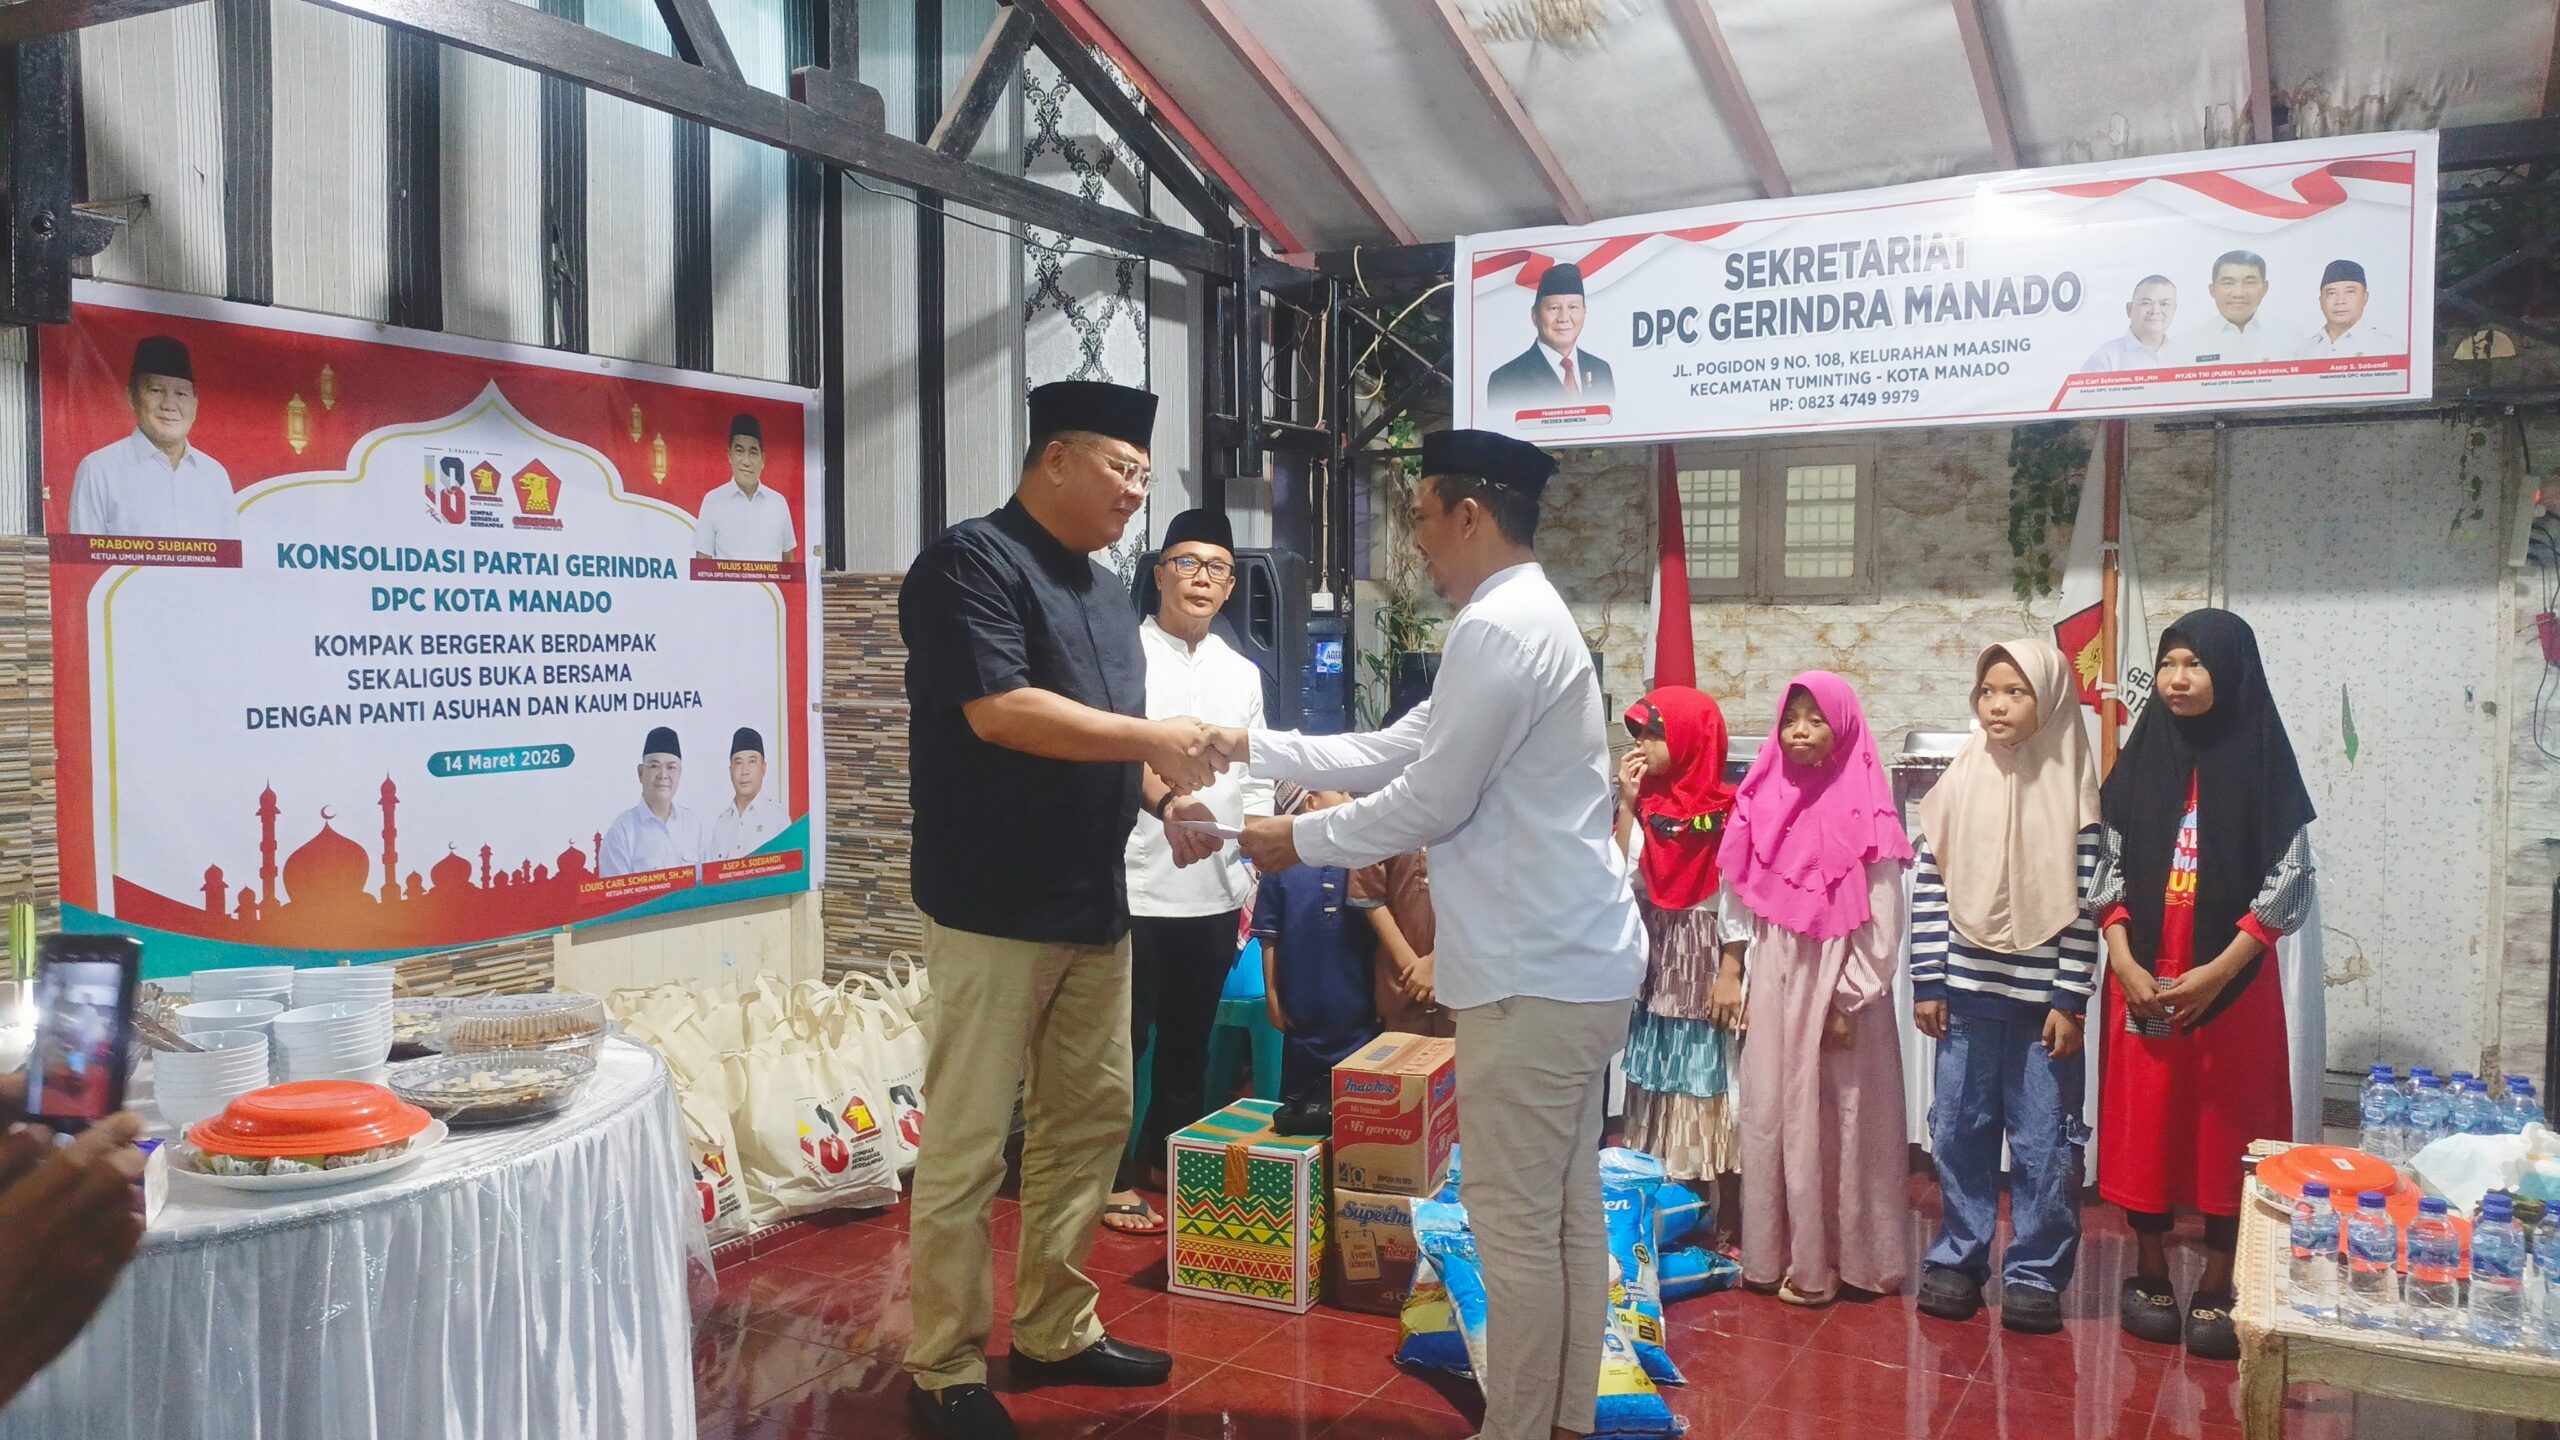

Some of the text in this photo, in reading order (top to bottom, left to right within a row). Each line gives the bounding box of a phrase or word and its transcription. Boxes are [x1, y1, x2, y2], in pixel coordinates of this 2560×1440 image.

[1632, 272, 2081, 347] DPC GERINDRA MANADO
[1673, 338, 2031, 379] JL. POGIDON 9 NO. 108, KELURAHAN MAASING
[1690, 376, 1781, 396] KECAMATAN
[1786, 371, 1871, 392] TUMINTING
[1887, 367, 1929, 384] KOTA
[1935, 362, 2010, 381] MANADO
[1769, 390, 1919, 412] HP: 0823 4749 9979
[89, 538, 217, 553] PRABOWO SUBIANTO
[91, 552, 217, 563] KETUA UMUM PARTAI GERINDRA
[277, 542, 678, 580] KONSOLIDASI PARTAI GERINDRA
[716, 562, 778, 572] YULIUS SELVANUS
[371, 586, 612, 614] DPC KOTA MANADO
[314, 632, 657, 657] KOMPAK BERGERAK BERDAMPAK
[347, 662, 632, 691] SEKALIGUS BUKA BERSAMA
[246, 688, 702, 731] DENGAN PANTI ASUHAN DAN KAUM DHUAFA
[443, 748, 561, 772] 14 Maret 2026
[722, 859, 741, 871] ASEP
[580, 880, 605, 894] LOUIS
[605, 877, 627, 890] CARL
[628, 871, 668, 888] SCHRAMM,
[1365, 1124, 1413, 1140] goreng
